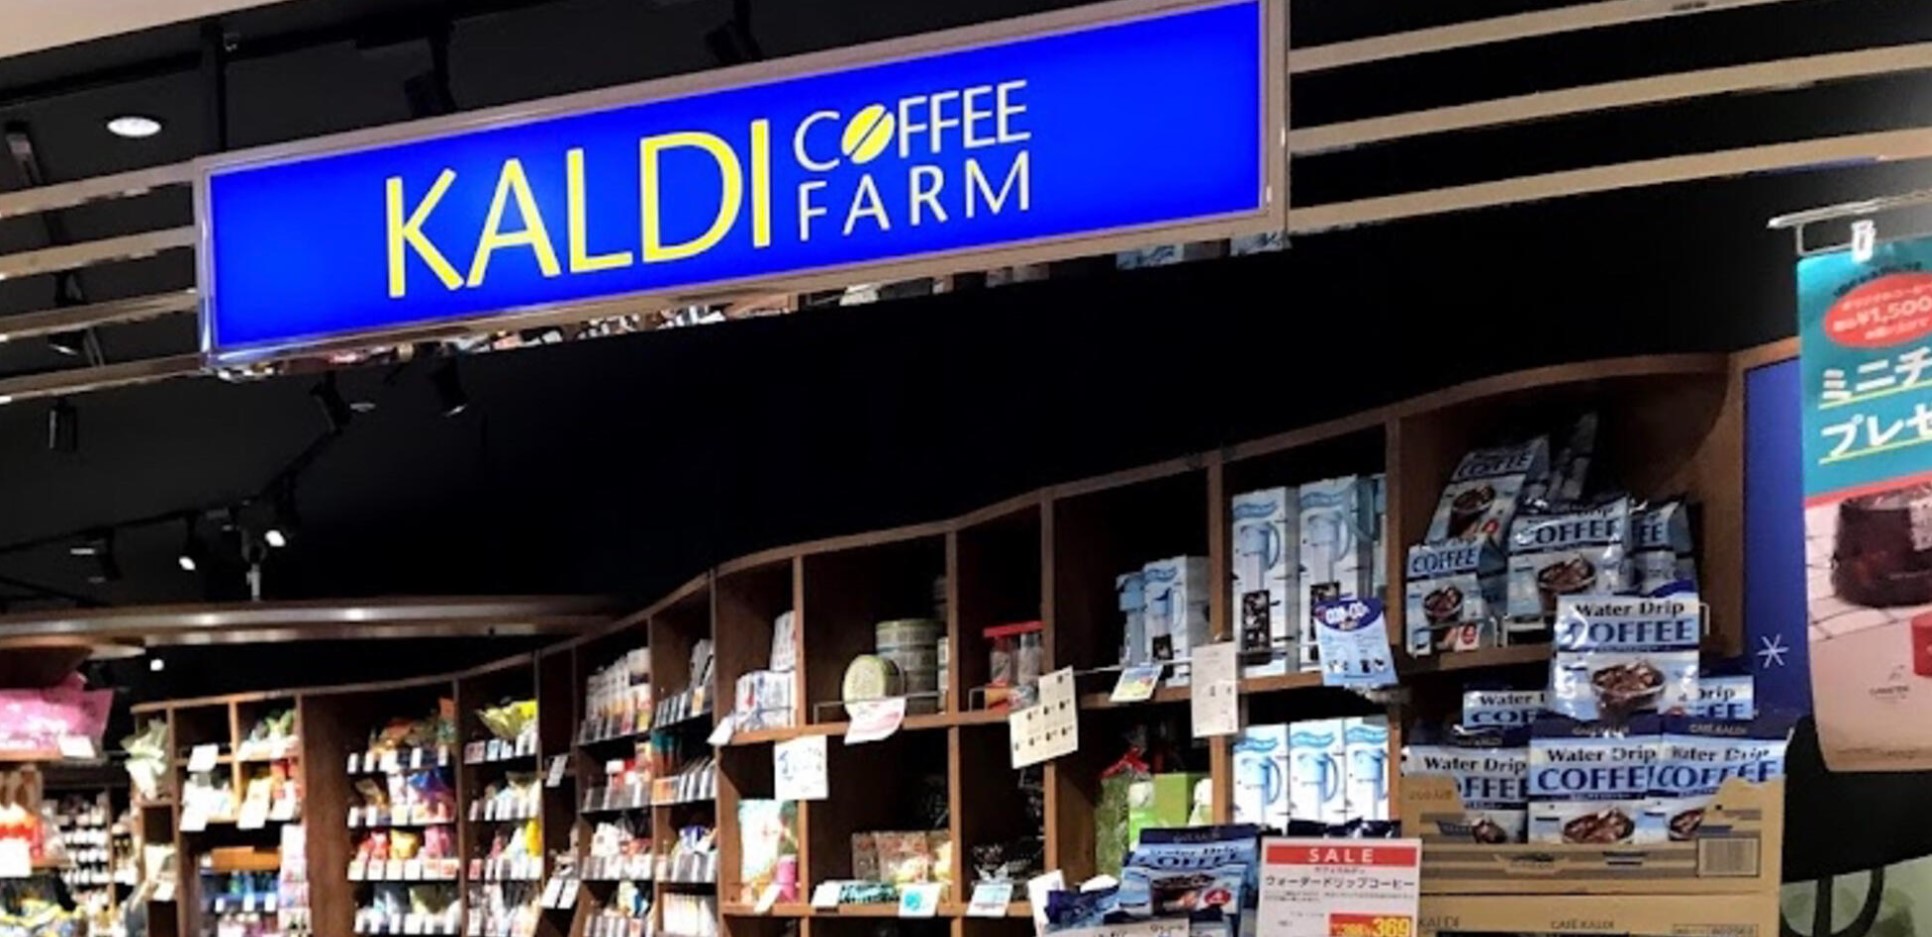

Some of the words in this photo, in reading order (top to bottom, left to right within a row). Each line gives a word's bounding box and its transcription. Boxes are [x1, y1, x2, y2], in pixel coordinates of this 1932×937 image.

[793, 80, 1031, 172] COFFEE
[798, 151, 1030, 241] FARM
[385, 118, 770, 298] KALDI
[1822, 347, 1932, 400] ミニチ
[1412, 549, 1476, 573] COFFEE
[1575, 602, 1632, 617] Water
[1640, 601, 1685, 618] Drip
[1480, 693, 1533, 706] Water
[1548, 748, 1603, 763] Water
[1611, 745, 1657, 764] Drip
[1424, 757, 1478, 772] Water
[1483, 757, 1527, 775] Drip
[1658, 761, 1777, 788] COFFEE
[1457, 777, 1529, 799] FFEE
[1308, 848, 1374, 863] SALE
[1371, 917, 1411, 937] 369
